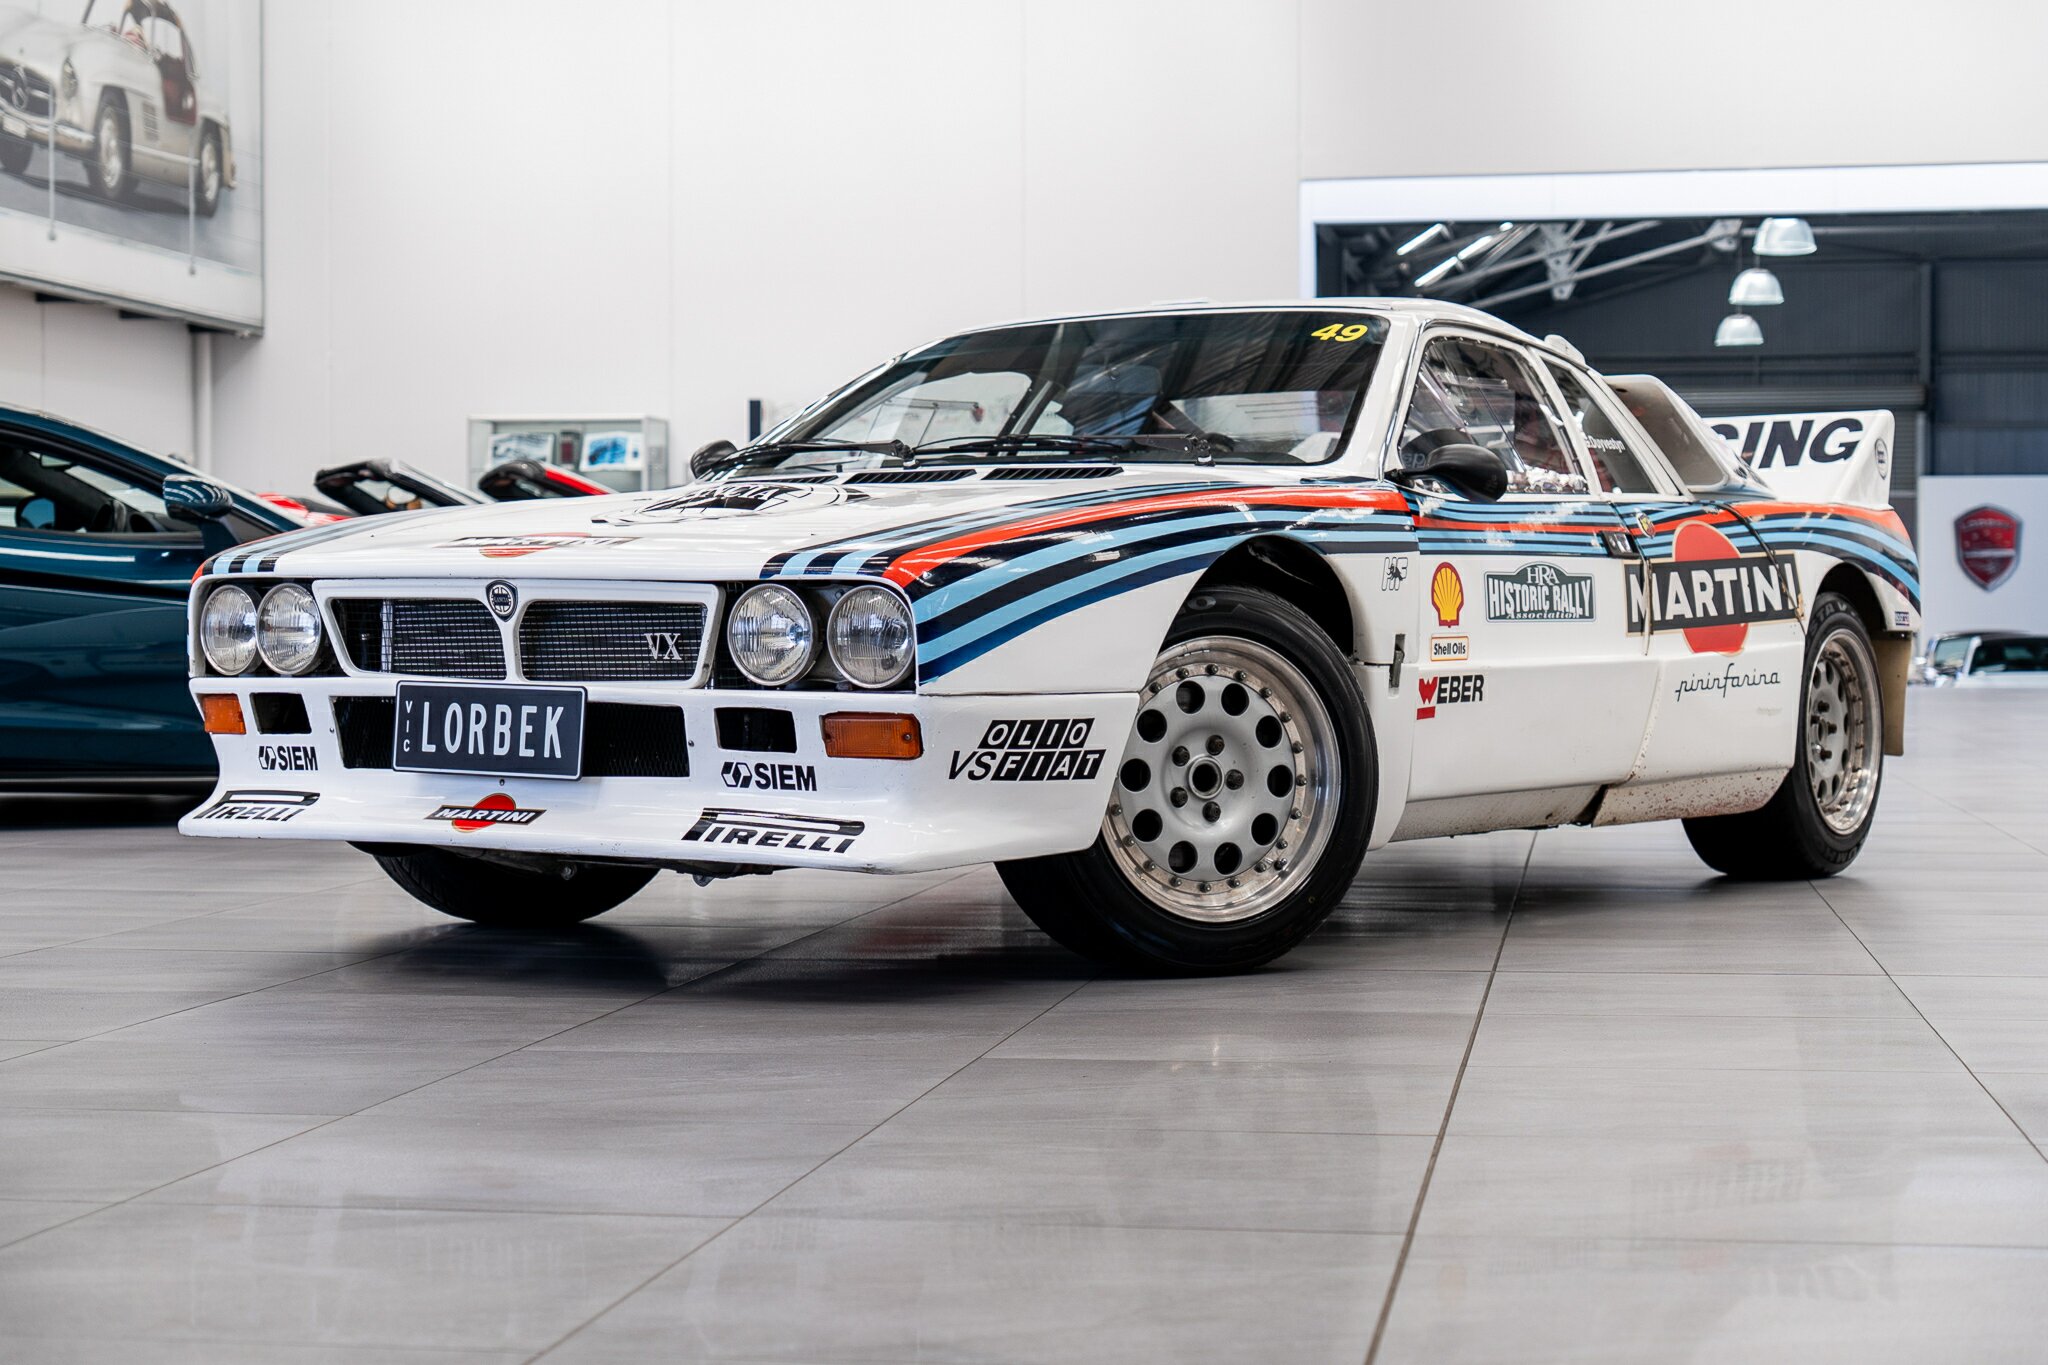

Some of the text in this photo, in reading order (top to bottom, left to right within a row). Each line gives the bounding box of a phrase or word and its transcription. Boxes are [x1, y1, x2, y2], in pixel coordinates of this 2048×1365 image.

[1311, 323, 1368, 342] 49
[1527, 565, 1560, 586] HRA
[1488, 577, 1591, 618] HISTORIC RALLY
[1628, 562, 1798, 624] MARTINI
[1505, 609, 1580, 620] Association
[644, 633, 682, 660] VX
[1433, 641, 1466, 656] Shell Oils
[1418, 674, 1485, 704] WEBER
[1675, 662, 1782, 702] pininfarina
[403, 701, 413, 752] VIC
[421, 701, 565, 759] LORBEK
[986, 721, 1089, 747] OLIO
[278, 745, 319, 771] SIEM
[753, 762, 818, 792] SIEM
[193, 789, 321, 822] PIRELLI
[437, 808, 536, 823] MARTINI
[681, 807, 865, 854] PIRELLI
